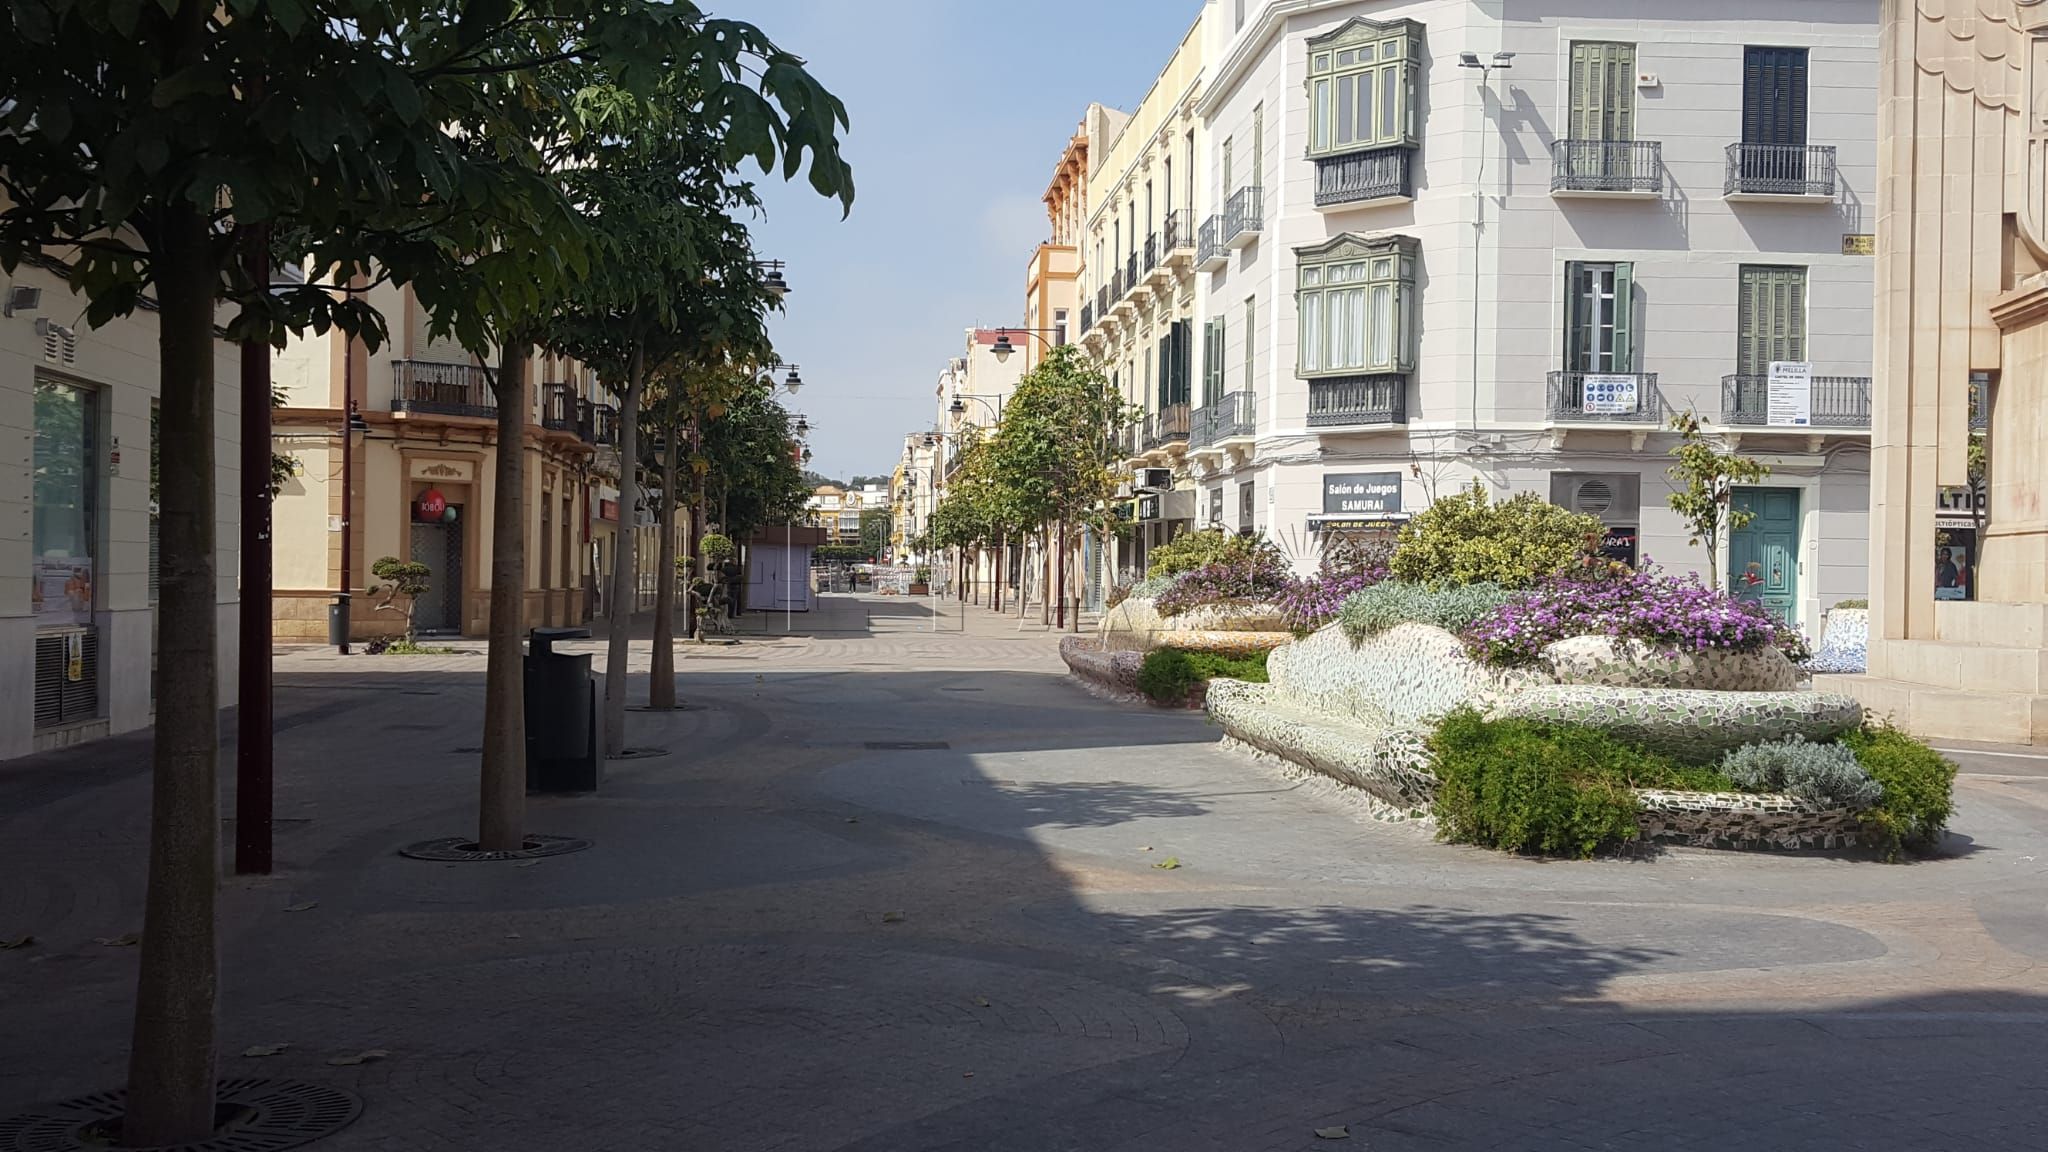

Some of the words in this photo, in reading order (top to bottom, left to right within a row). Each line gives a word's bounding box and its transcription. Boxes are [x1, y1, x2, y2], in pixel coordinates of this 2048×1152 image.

[1328, 482, 1352, 495] Salón
[1353, 483, 1364, 494] de
[1365, 482, 1398, 496] Juegos
[1341, 499, 1384, 511] SAMURAI
